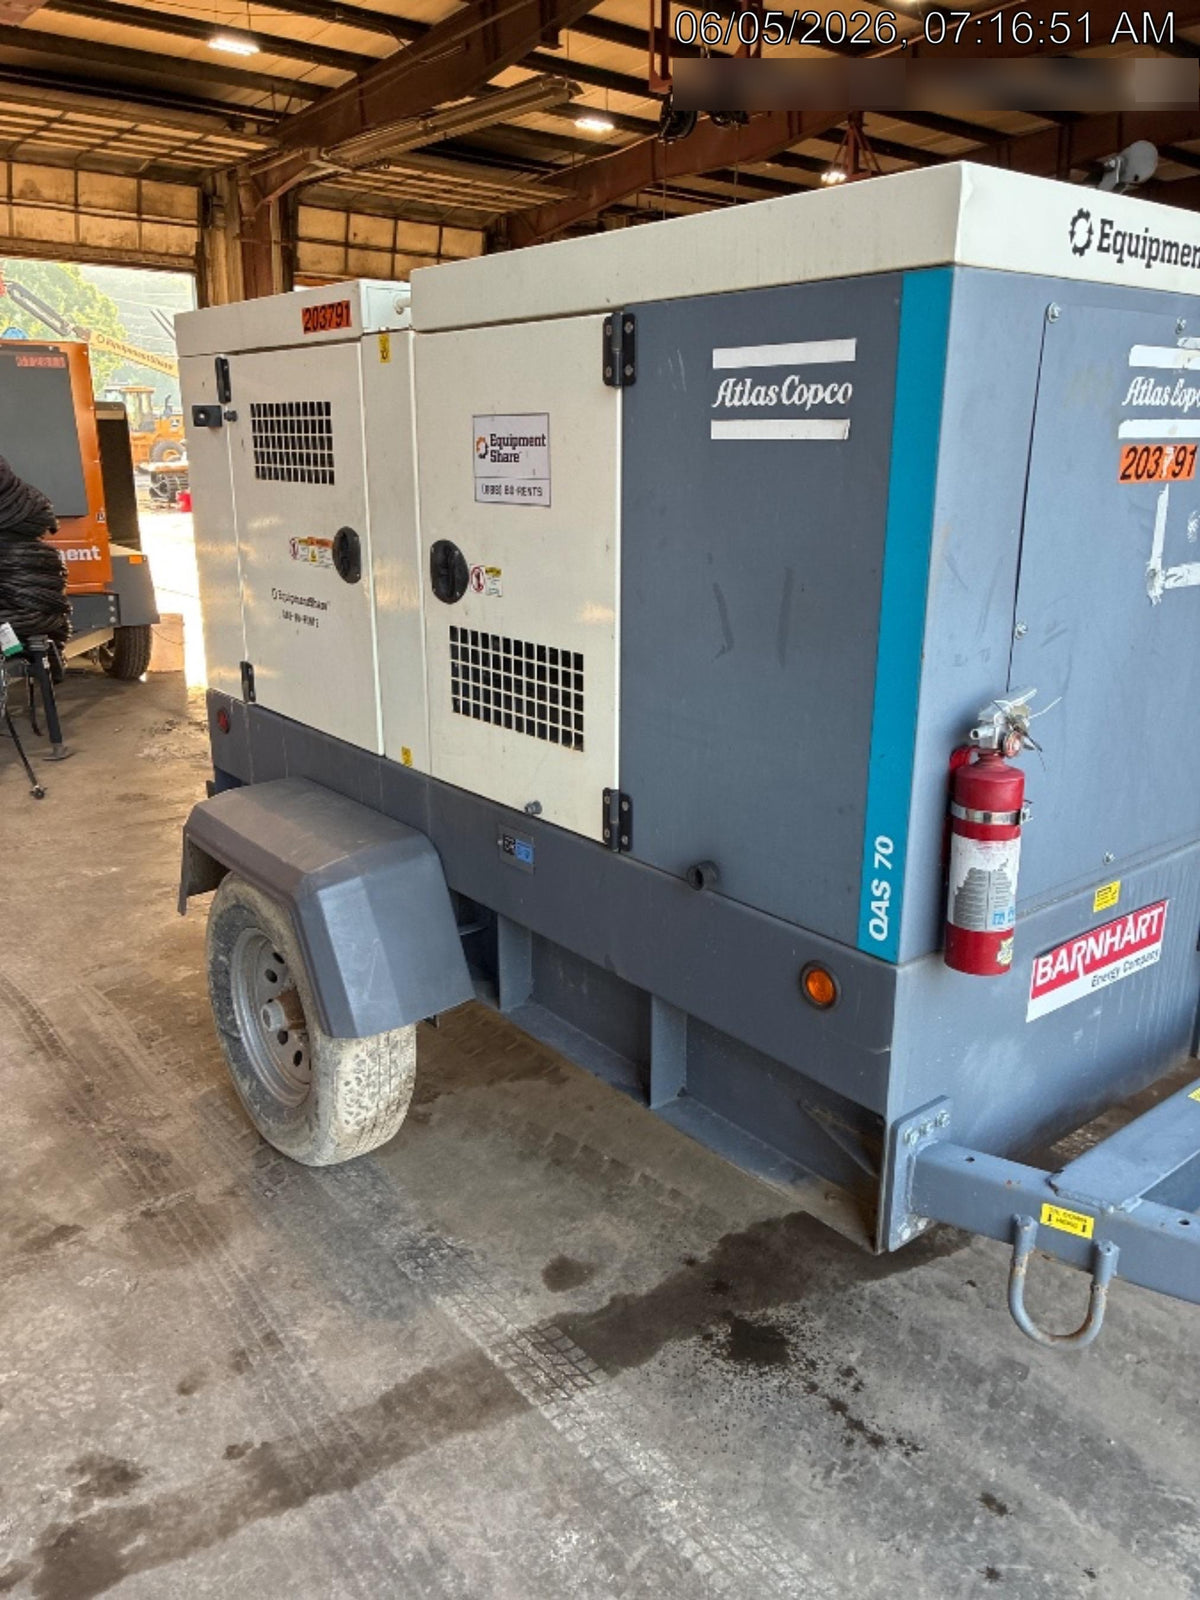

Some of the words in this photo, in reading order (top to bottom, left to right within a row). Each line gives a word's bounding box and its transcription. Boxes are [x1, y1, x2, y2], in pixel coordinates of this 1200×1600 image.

[303, 301, 350, 332] 203791
[712, 377, 778, 408] Atlas
[780, 374, 853, 411] Copco
[1122, 376, 1170, 406] Atlas
[490, 433, 546, 450] Equipment
[490, 450, 520, 463] Share
[1120, 445, 1198, 481] 203791
[873, 835, 894, 870] 70
[1035, 906, 1164, 988] BARNHART
[1091, 966, 1120, 988] Energy
[1123, 949, 1160, 973] Company
